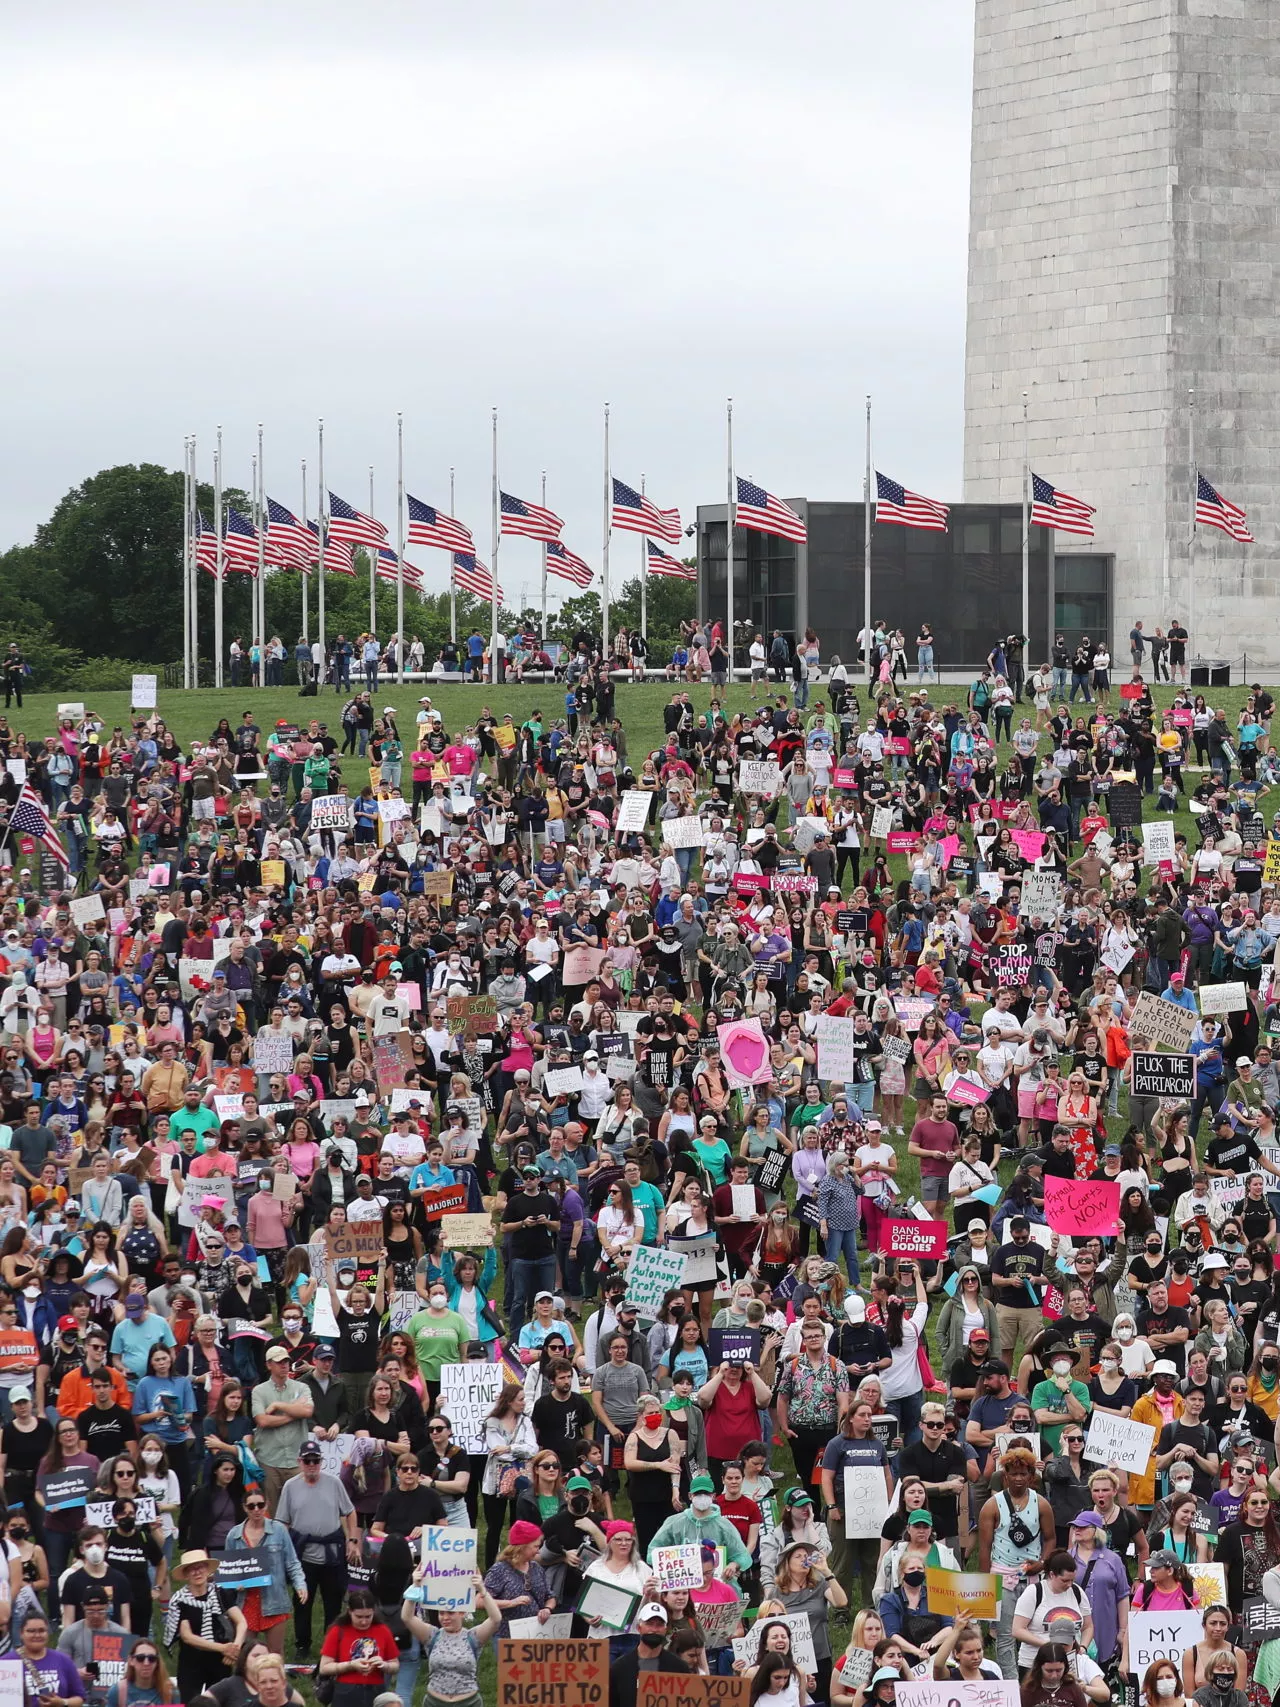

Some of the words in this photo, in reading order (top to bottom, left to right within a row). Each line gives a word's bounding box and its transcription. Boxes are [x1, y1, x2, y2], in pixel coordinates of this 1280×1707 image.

[748, 762, 763, 771] KEEP
[745, 781, 766, 790] SAFE
[313, 816, 347, 828] JESUS
[1031, 875, 1056, 883] MOMS
[1036, 886, 1044, 895] 4
[1000, 944, 1027, 957] STOP
[989, 957, 1031, 968] PLAYIN
[994, 967, 1014, 976] WITH
[1018, 966, 1030, 974] MY
[999, 974, 1029, 985] PUSSY
[1141, 994, 1153, 1004] WE
[1155, 998, 1193, 1019] DEMAND
[1136, 1010, 1192, 1035] PROTECTION
[1150, 1007, 1182, 1025] LEGAL
[1131, 1022, 1185, 1048] ABORTION!!
[603, 1043, 623, 1053] BODY
[651, 1052, 667, 1063] HOW
[651, 1063, 668, 1073] DARE
[1136, 1056, 1163, 1073] FUCK
[1167, 1057, 1189, 1074] THE
[651, 1074, 669, 1084] THEY.
[1136, 1074, 1194, 1094] PATRIARCHY
[767, 1151, 786, 1166] HOW
[763, 1161, 783, 1177] DARE
[759, 1171, 778, 1188] THEY.
[427, 1196, 463, 1213] MAJORITY
[1075, 1198, 1109, 1229] NOW
[328, 1226, 345, 1237] WE
[892, 1225, 920, 1235] BANS
[334, 1239, 352, 1253] GO
[356, 1238, 382, 1252] BACK
[891, 1234, 913, 1242] OFF
[912, 1235, 936, 1244] OUR
[891, 1242, 932, 1252] BODIES
[635, 1248, 683, 1272] Protect
[631, 1265, 681, 1284] Autonomy.
[722, 1347, 752, 1359] BODY
[447, 1368, 467, 1384] I'M
[471, 1366, 498, 1383] WAY
[443, 1386, 466, 1403] TOO
[469, 1384, 500, 1401] FINE
[452, 1406, 467, 1420] TO
[471, 1404, 487, 1418] BE
[46, 1479, 73, 1491] Abortion
[74, 1478, 84, 1487] is
[46, 1489, 71, 1498] Health
[71, 1486, 90, 1495] Care.
[88, 1503, 112, 1515] WE
[855, 1505, 877, 1517] Our
[852, 1517, 881, 1533] Bodies
[427, 1527, 477, 1554] Keep
[218, 1566, 243, 1575] Health
[243, 1565, 263, 1573] Care.
[219, 1559, 249, 1568] Abortion
[423, 1561, 475, 1579] Abortion
[658, 1559, 685, 1571] SAFE
[660, 1567, 695, 1581] LEGAL
[660, 1576, 702, 1590] ABORTION
[423, 1587, 471, 1612] Legal
[957, 1589, 994, 1599] ABORTION
[700, 1602, 725, 1615] DON'T
[752, 1625, 762, 1638] IF
[1149, 1626, 1182, 1643] MY
[93, 1636, 123, 1648] FIGHT
[503, 1645, 516, 1662] I
[522, 1643, 601, 1661] SUPPORT
[530, 1663, 576, 1682] HER
[503, 1684, 567, 1705] RIGHT
[577, 1682, 602, 1701] TO
[642, 1678, 690, 1695] AMY
[701, 1680, 743, 1698] YOU
[897, 1689, 941, 1707] Ruth
